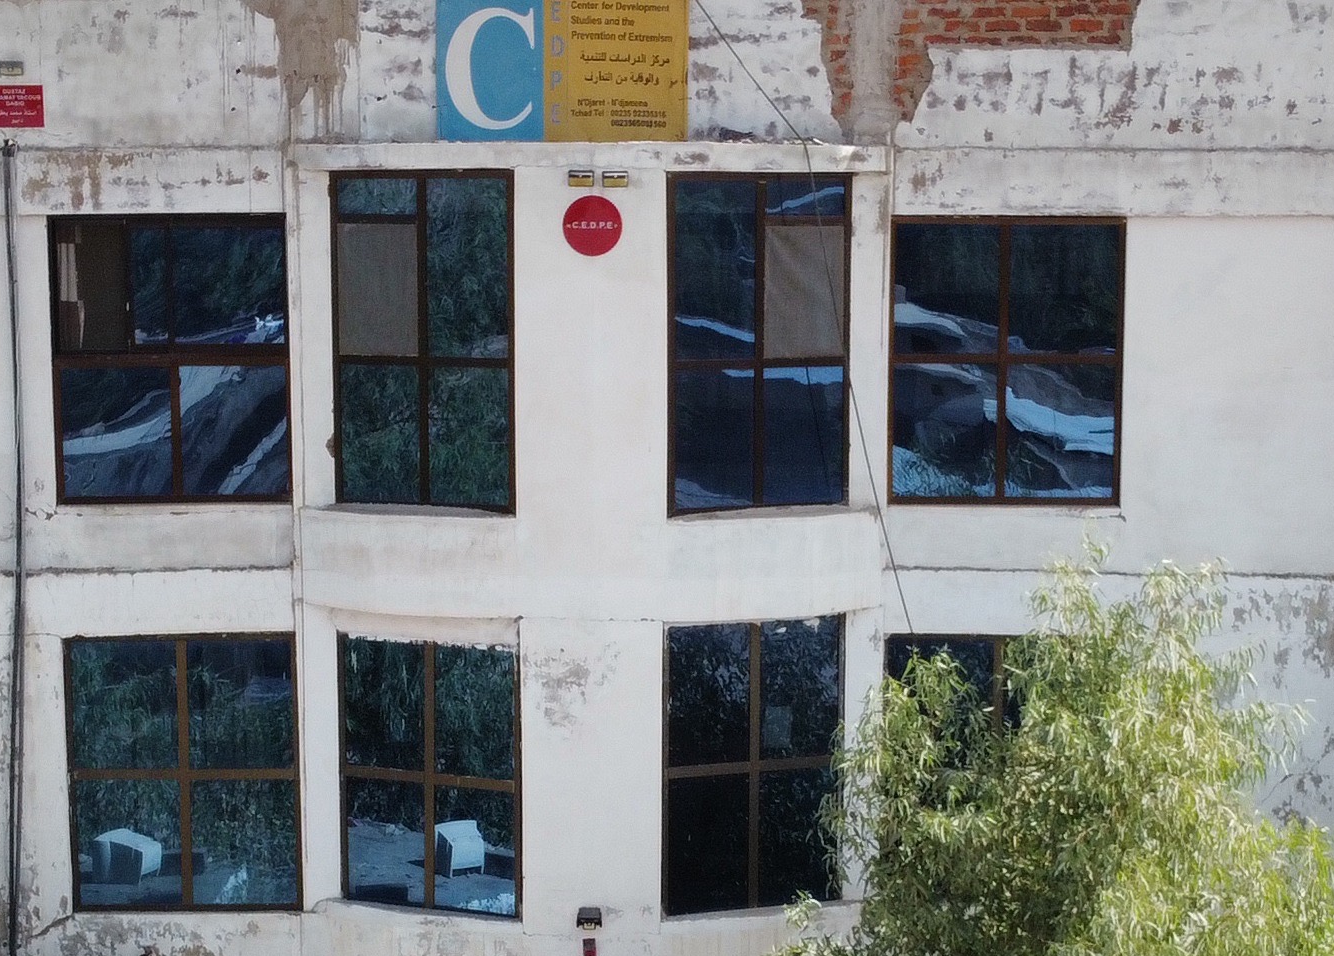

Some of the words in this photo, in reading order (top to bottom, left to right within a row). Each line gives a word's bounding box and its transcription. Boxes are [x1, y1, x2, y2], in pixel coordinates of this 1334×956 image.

[571, 1, 599, 10] Center
[601, 1, 614, 10] for
[616, 2, 670, 14] Development
[571, 15, 602, 25] Studies
[604, 16, 620, 26] and
[621, 17, 636, 26] the
[571, 30, 616, 41] Prevention
[618, 31, 627, 41] of
[628, 32, 673, 42] Extremism
[445, 7, 535, 130] C
[570, 108, 593, 117] Tchad
